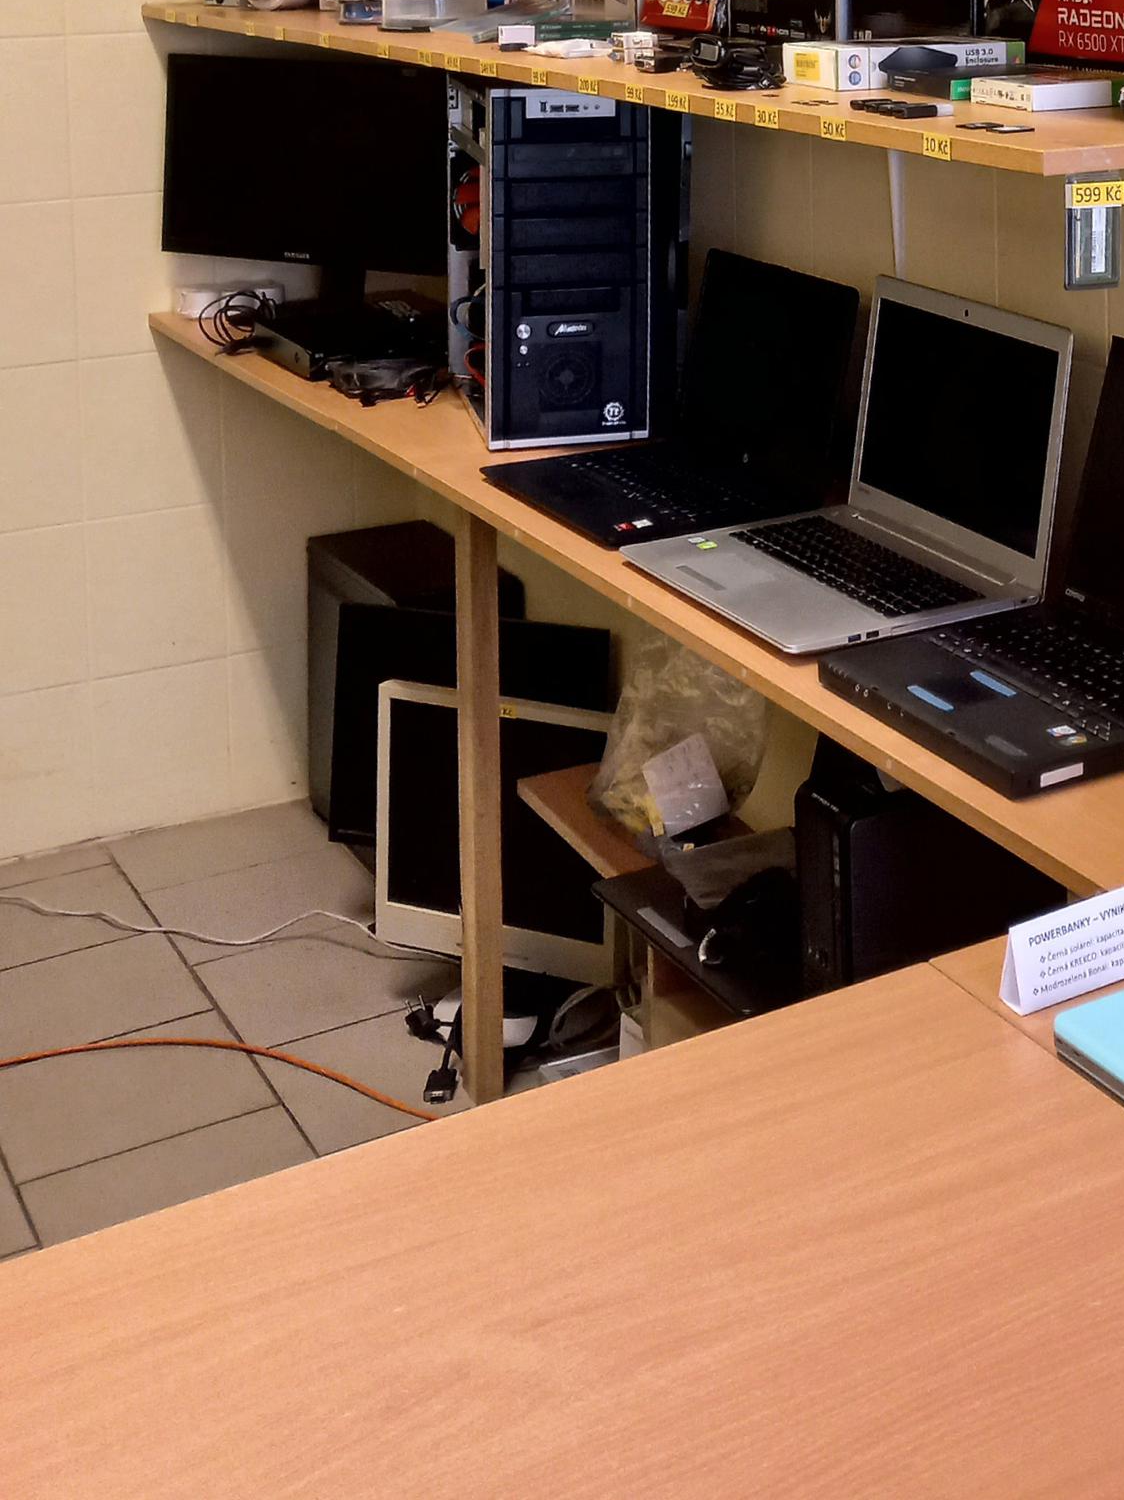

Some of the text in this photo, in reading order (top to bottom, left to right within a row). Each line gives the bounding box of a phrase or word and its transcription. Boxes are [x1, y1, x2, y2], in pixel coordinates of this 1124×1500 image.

[1058, 30, 1074, 48] RX
[1077, 32, 1107, 52] 6500
[965, 55, 999, 66] Enclosure
[667, 93, 688, 109] 199 Kč
[715, 103, 735, 118] 35 Kč
[756, 110, 778, 125] 30 Kč
[822, 121, 846, 138] 50 Kč
[925, 137, 949, 155] 10 Kč
[1075, 185, 1122, 203] 599 Kč
[1028, 916, 1091, 947] POWERBANKY
[1047, 948, 1069, 963] Černá
[1096, 928, 1124, 945] kapacita
[1047, 962, 1069, 977] Černá
[1040, 972, 1087, 994] Modrozelená
